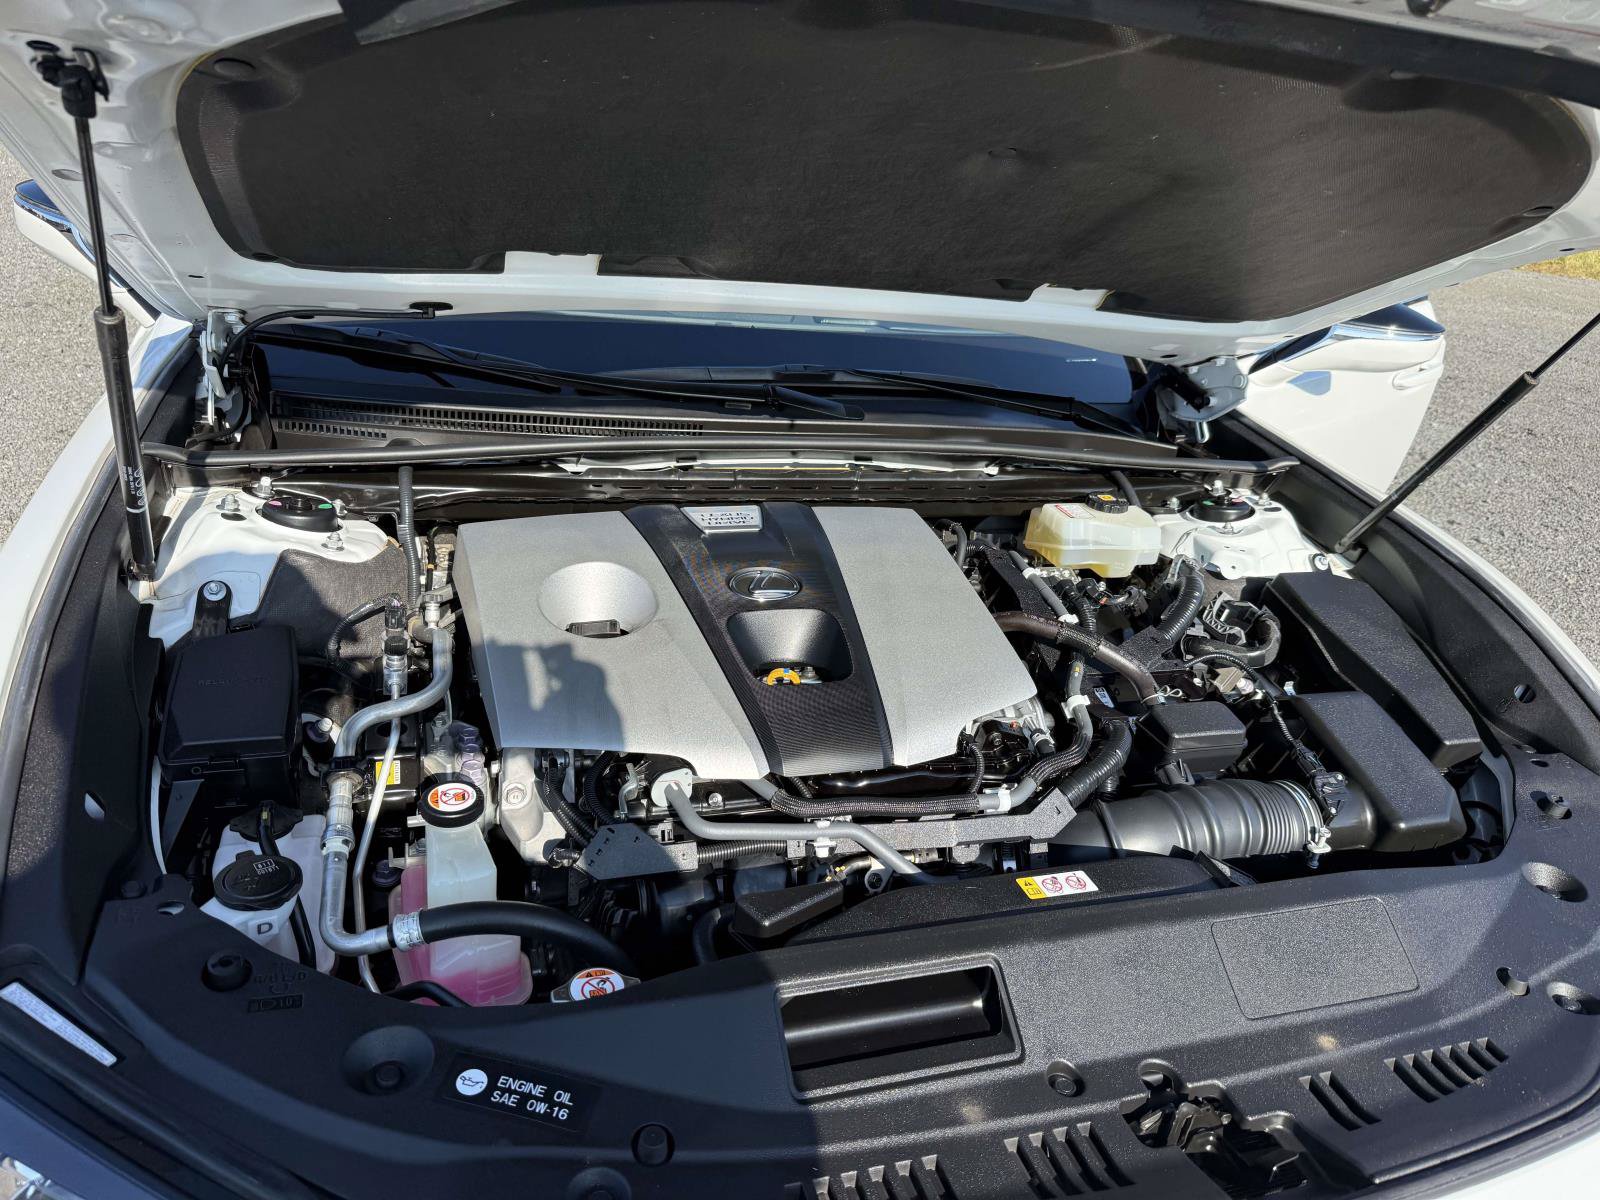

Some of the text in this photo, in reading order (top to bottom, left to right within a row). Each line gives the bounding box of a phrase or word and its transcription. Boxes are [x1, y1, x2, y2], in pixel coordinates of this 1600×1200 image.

[490, 1090, 570, 1120] SAE 0W-16
[497, 1075, 574, 1106] ENGINE OIL
